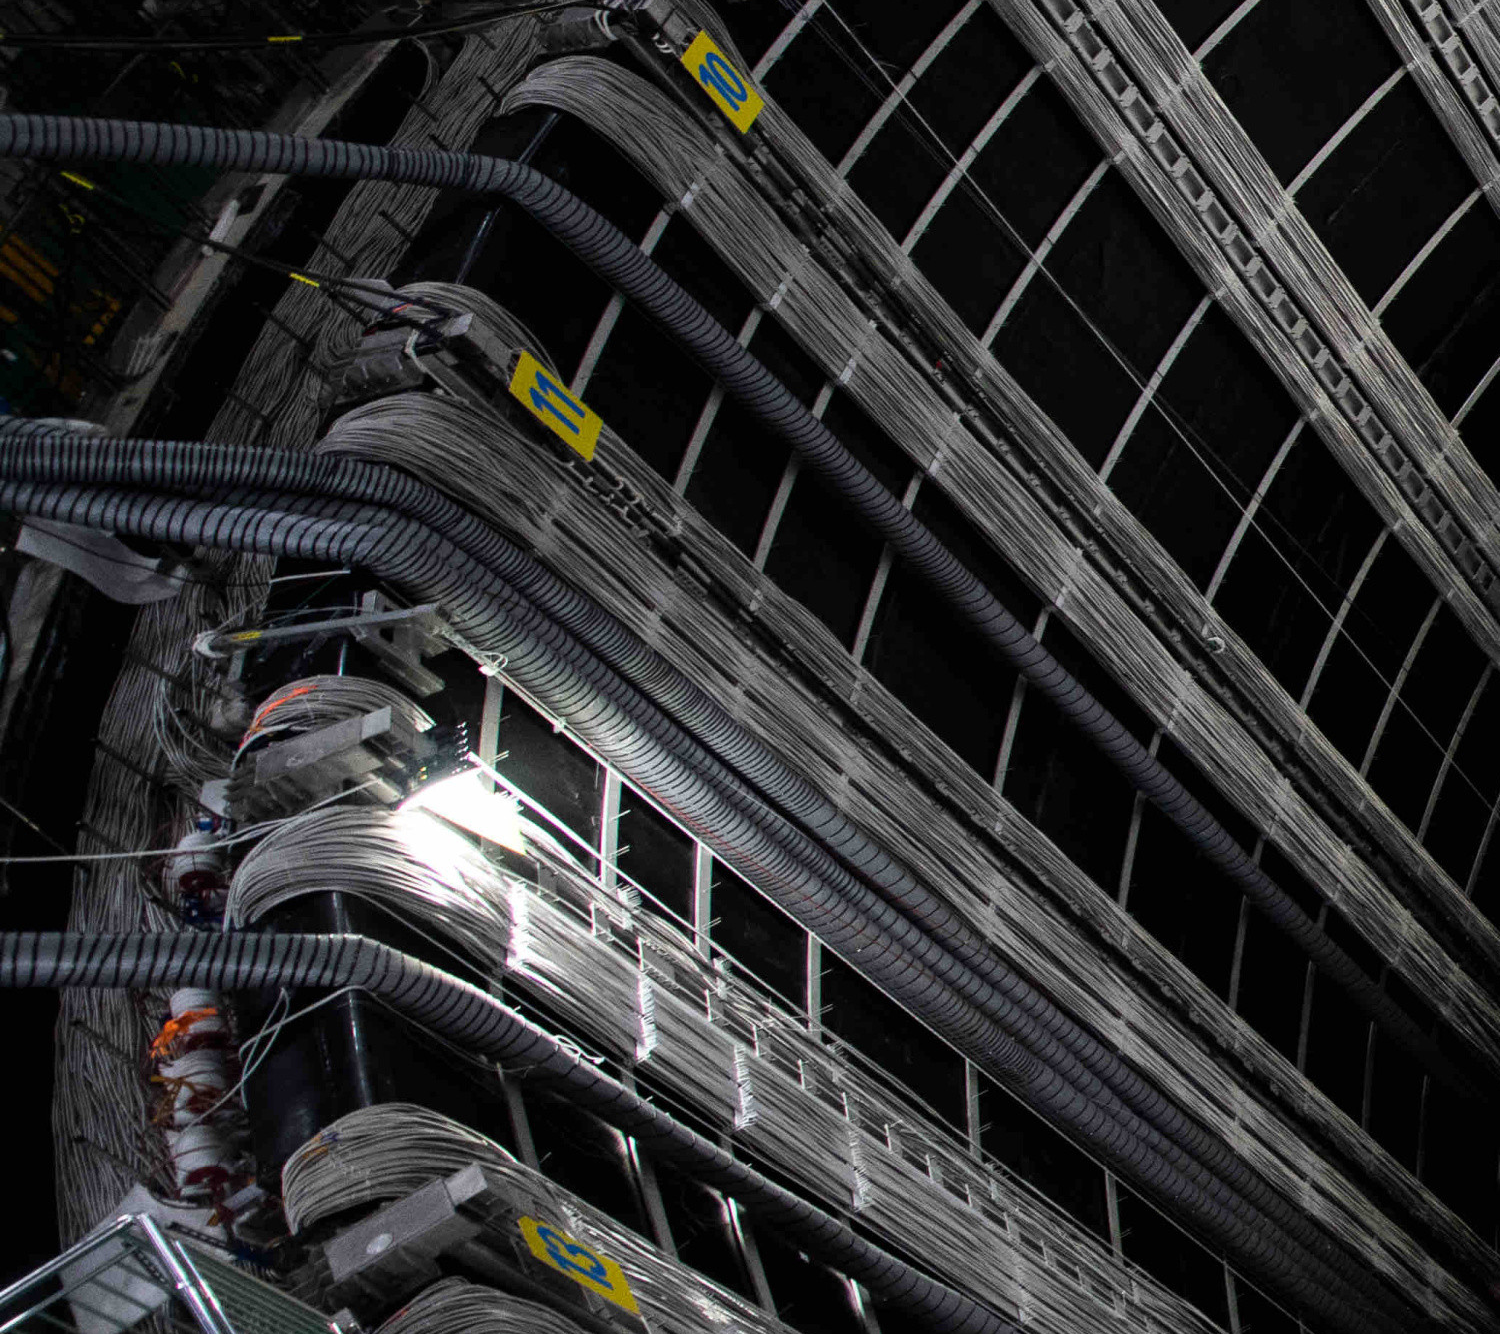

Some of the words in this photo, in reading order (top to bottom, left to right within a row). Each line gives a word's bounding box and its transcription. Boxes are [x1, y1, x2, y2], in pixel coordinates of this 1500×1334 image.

[698, 52, 748, 112] 10
[529, 370, 585, 434] 11
[536, 1226, 612, 1289] 13
